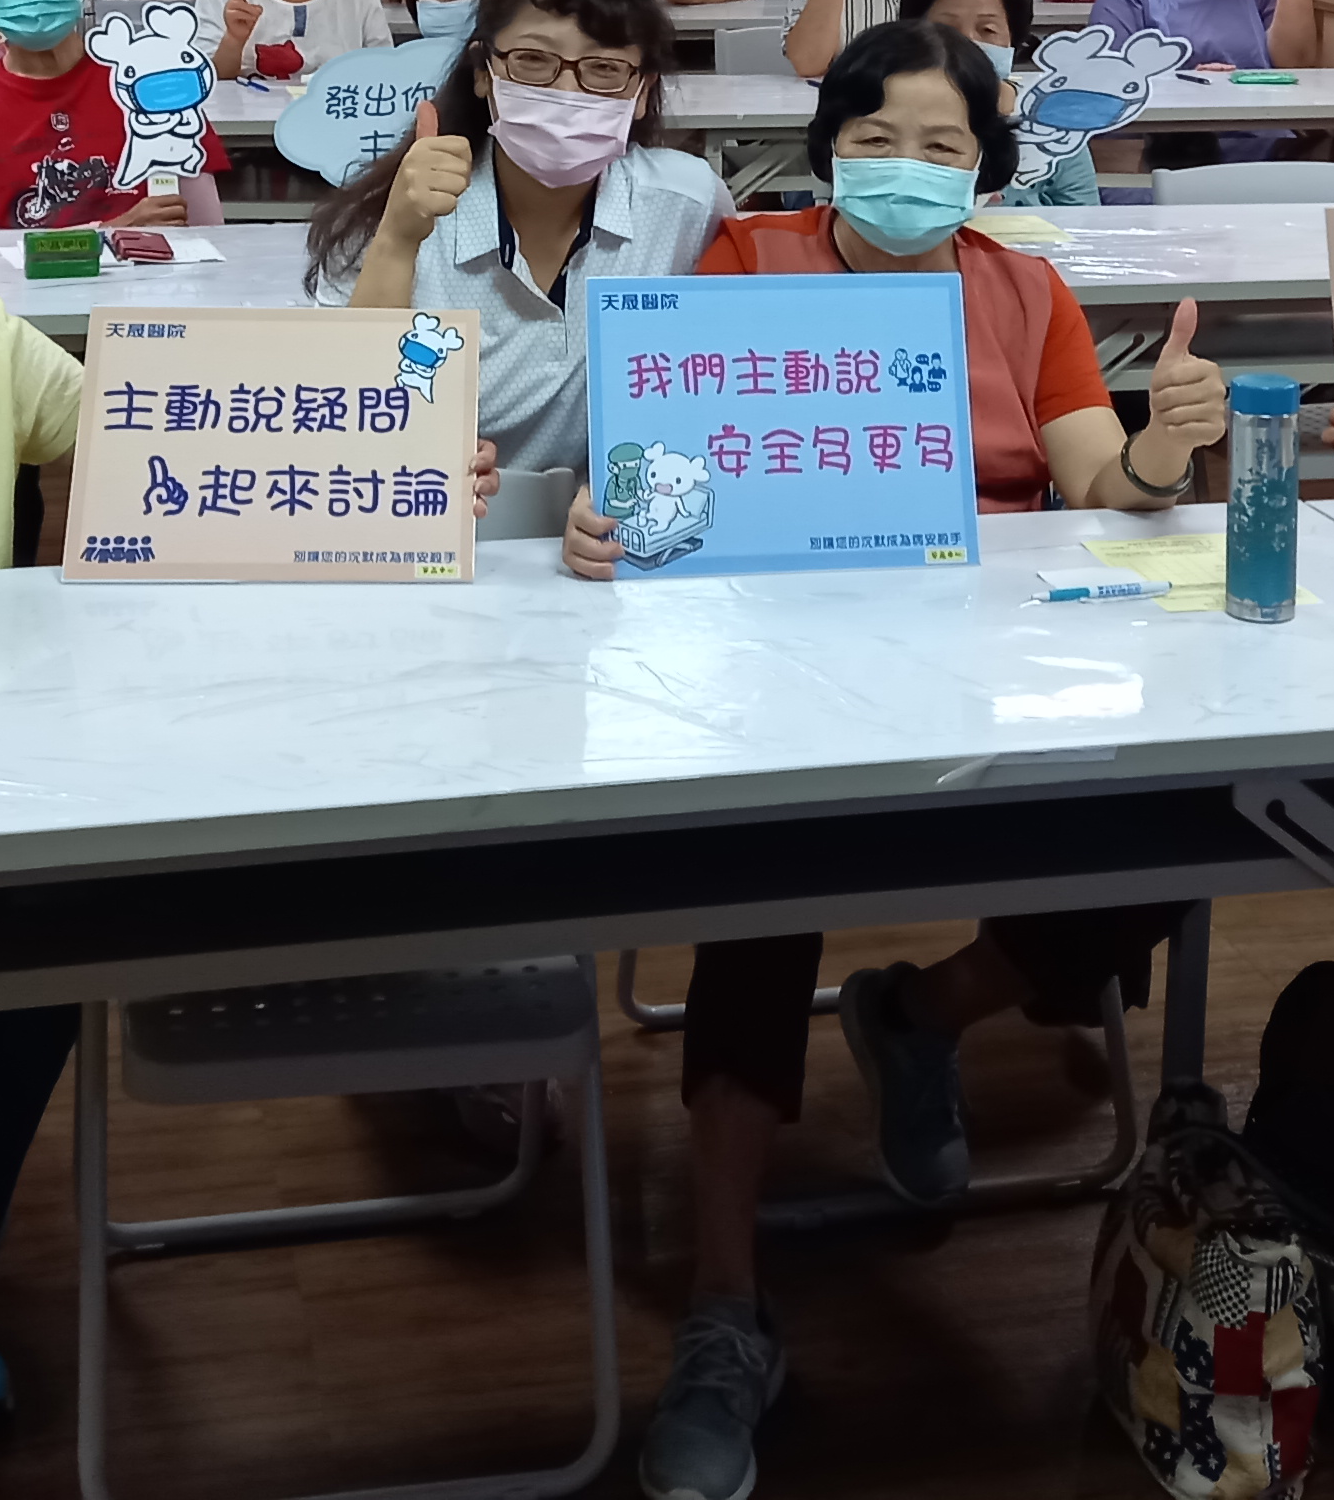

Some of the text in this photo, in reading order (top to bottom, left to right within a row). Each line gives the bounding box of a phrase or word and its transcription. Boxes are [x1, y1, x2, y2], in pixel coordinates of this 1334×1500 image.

[600, 292, 680, 311] 天晟醫院
[105, 322, 187, 339] 天晟醫院
[626, 347, 882, 399] 我們主動說
[103, 381, 410, 434] 主動說疑問
[706, 422, 955, 479] 安全多更多
